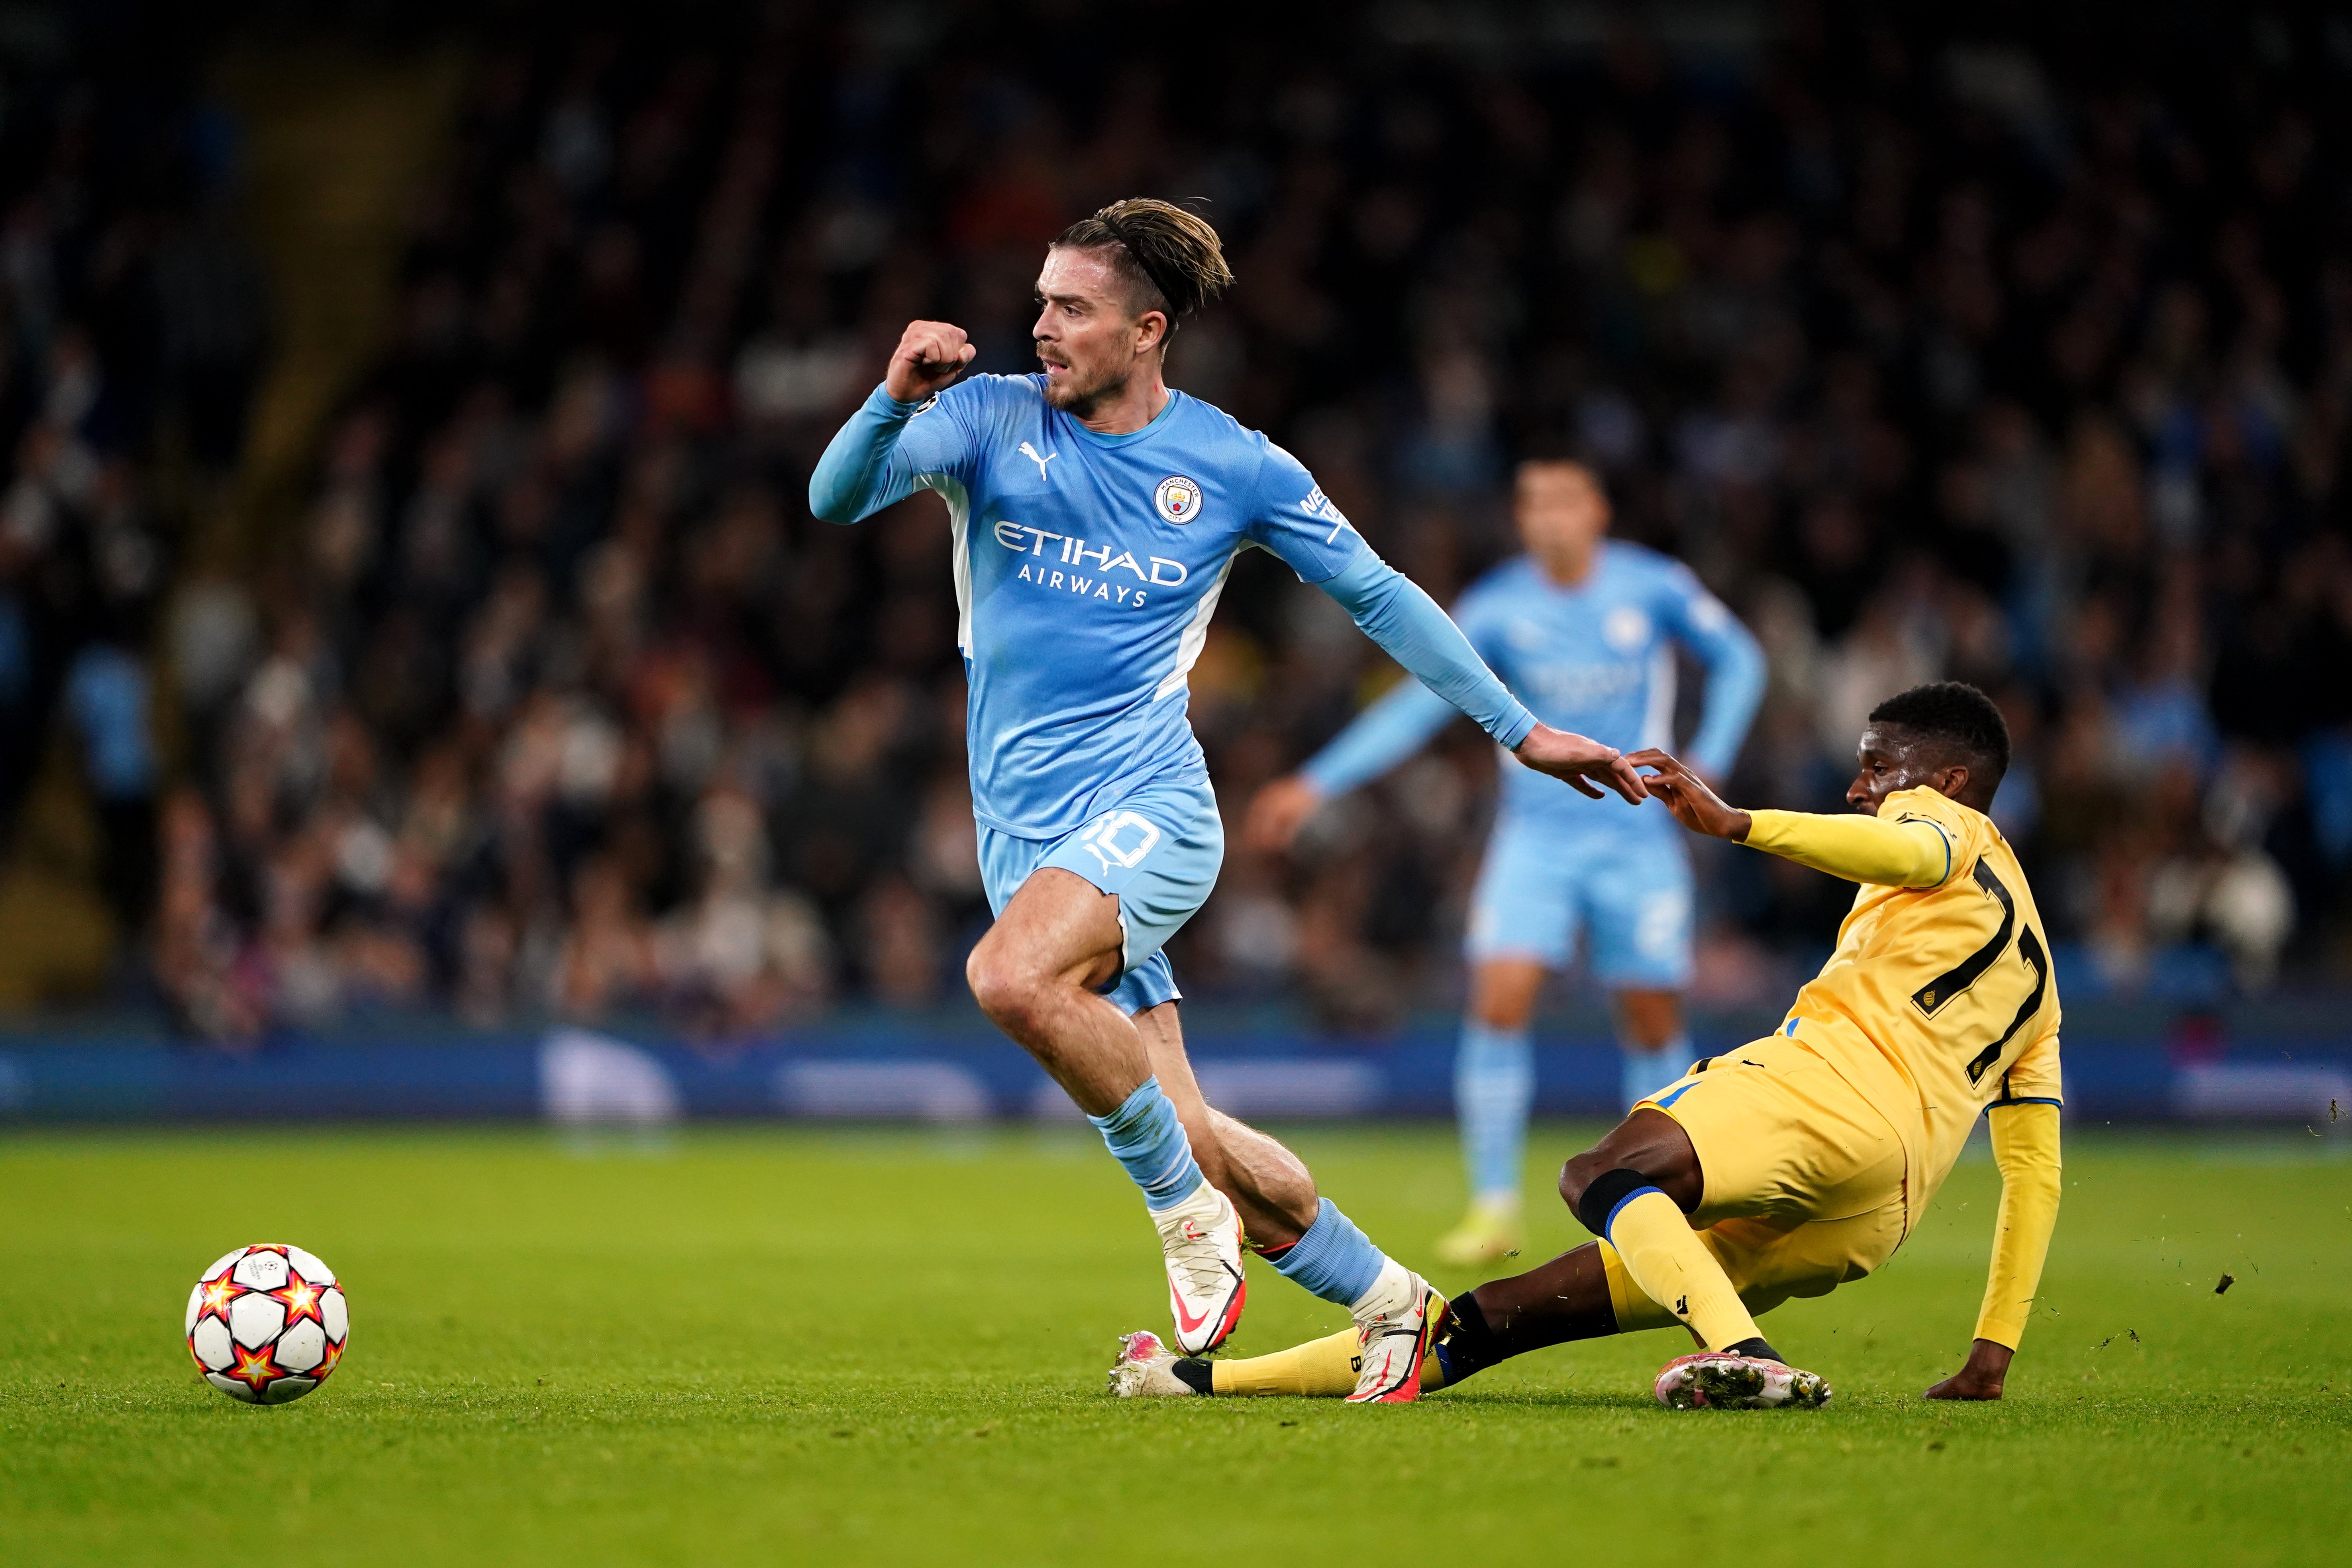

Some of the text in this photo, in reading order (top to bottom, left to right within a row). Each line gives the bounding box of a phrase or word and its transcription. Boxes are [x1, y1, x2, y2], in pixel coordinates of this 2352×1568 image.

[1161, 479, 1199, 497] MANCHESTER
[1300, 483, 1326, 516] NE
[994, 521, 1187, 587] ETIHAD
[1018, 564, 1147, 608] AIRWAYS
[1081, 810, 1160, 868] 10
[1911, 855, 2048, 1090] 77
